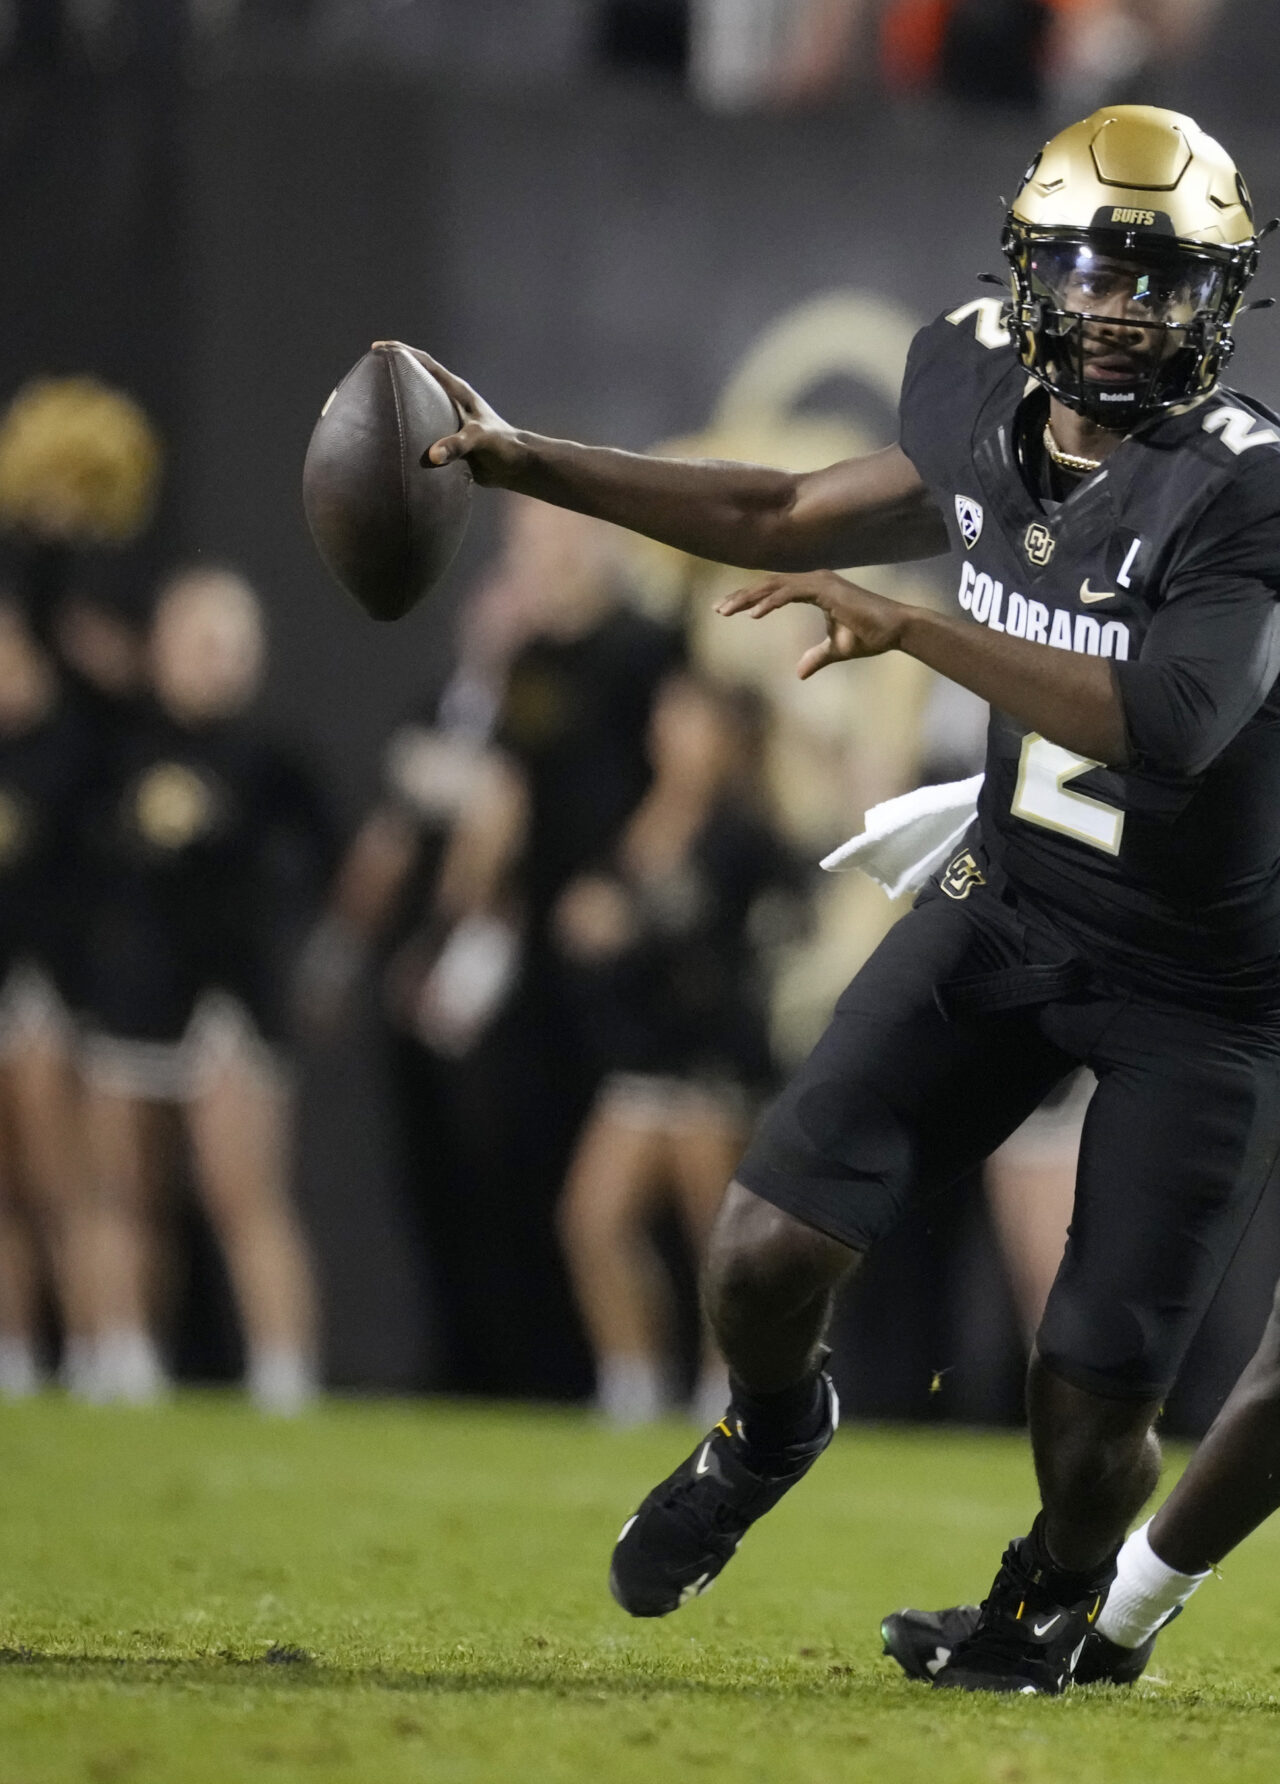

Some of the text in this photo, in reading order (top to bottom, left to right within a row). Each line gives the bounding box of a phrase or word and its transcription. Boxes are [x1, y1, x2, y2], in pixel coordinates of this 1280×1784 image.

[1111, 207, 1155, 226] BUFFS
[944, 297, 1011, 350] 2
[1100, 392, 1135, 402] Riddell
[1202, 406, 1280, 456] 2
[958, 560, 1131, 661] COLORADO
